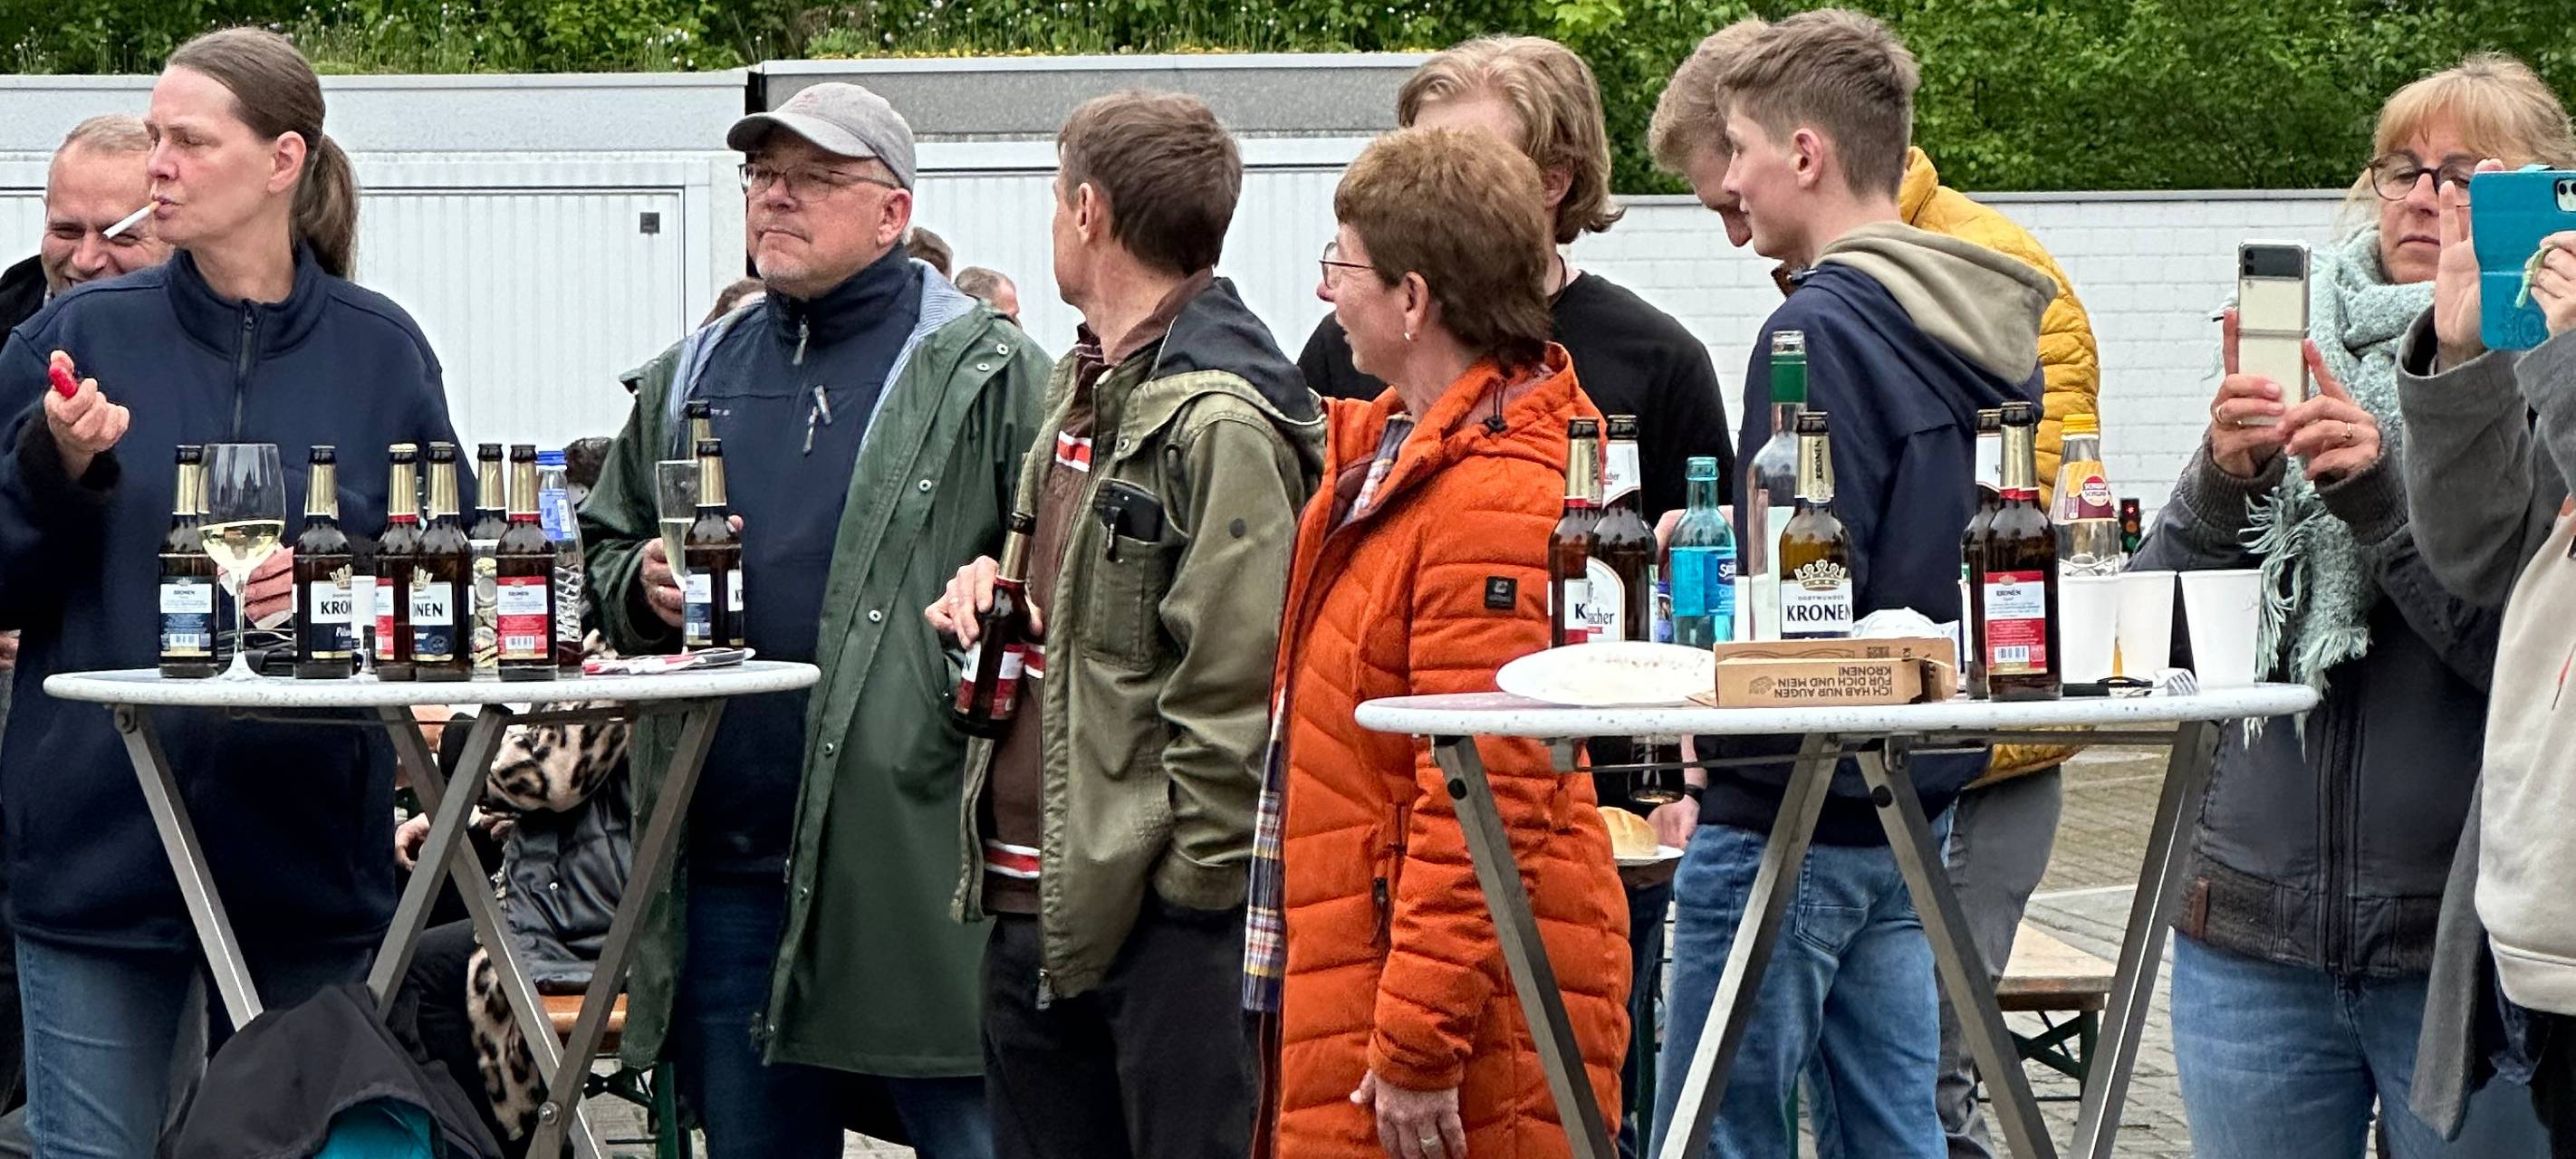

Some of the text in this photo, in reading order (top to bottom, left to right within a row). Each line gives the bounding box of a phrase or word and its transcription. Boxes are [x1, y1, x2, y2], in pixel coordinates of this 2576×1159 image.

[1786, 604, 1850, 621] KRONEN
[1839, 666, 1892, 675] KRONEN!
[1778, 676, 1892, 687] FÜR DICH UND MEIN
[1774, 686, 1893, 698] ICH HAB NUR AUGEN
